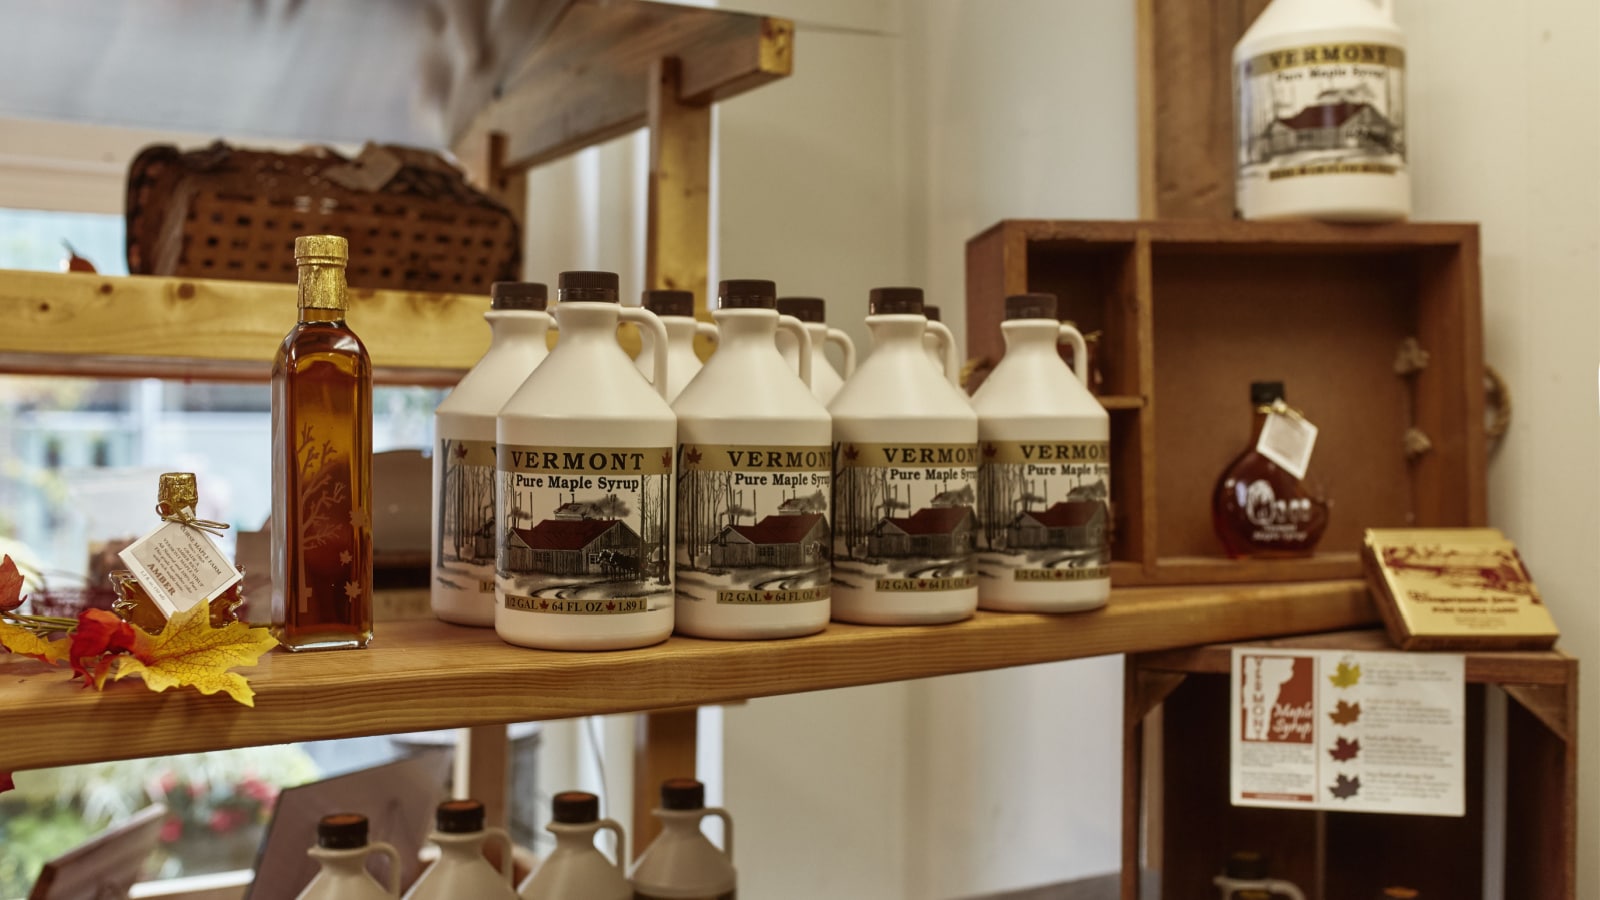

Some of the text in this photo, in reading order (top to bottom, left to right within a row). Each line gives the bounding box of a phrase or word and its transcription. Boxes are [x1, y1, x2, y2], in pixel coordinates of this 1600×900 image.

[1269, 45, 1386, 68] VERMONT
[511, 451, 645, 470] VERMONT
[882, 447, 978, 463] VERMON
[890, 469, 921, 480] Pure
[925, 469, 958, 483] Maple
[1027, 465, 1056, 475] Pure
[1061, 465, 1091, 478] Maple
[516, 474, 640, 492] Pure Maple Syrup
[735, 473, 768, 486] Pure
[772, 473, 809, 489] Maple
[162, 538, 181, 559] VERMONT
[179, 558, 192, 573] MAPLE
[193, 542, 209, 559] MAPLE
[207, 559, 221, 575] FARM
[146, 561, 177, 596] AMBER
[876, 580, 890, 590] 1/2
[892, 580, 916, 590] GAL
[928, 581, 939, 589] 64
[720, 590, 814, 602] 1/2 GAL 64 FL OZ
[517, 599, 538, 610] GAL
[552, 602, 563, 611] 64
[567, 602, 582, 612] FL
[585, 602, 603, 612] OZ
[618, 602, 637, 611] 1.89
[639, 601, 646, 610] L
[1253, 657, 1265, 740] VERMONT
[1273, 701, 1313, 726] Maple
[1272, 718, 1313, 741] Syrup
